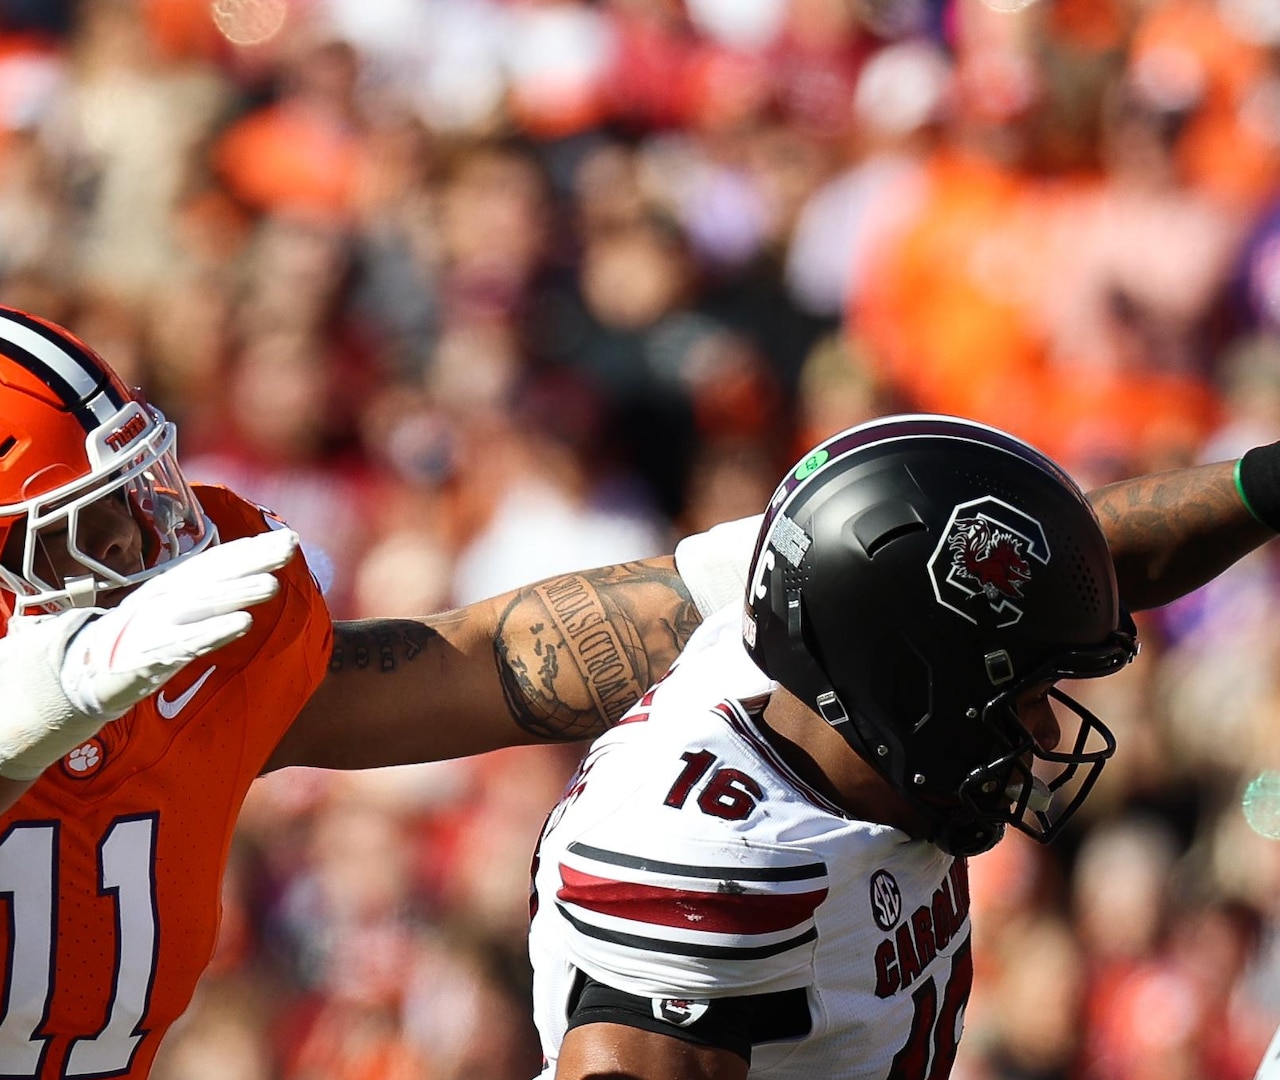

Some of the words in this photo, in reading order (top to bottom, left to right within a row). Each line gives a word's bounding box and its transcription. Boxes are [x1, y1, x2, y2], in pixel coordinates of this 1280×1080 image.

[567, 612, 605, 640] IS
[578, 630, 630, 701] WORLD
[663, 748, 764, 821] 16
[871, 870, 902, 931] SEC
